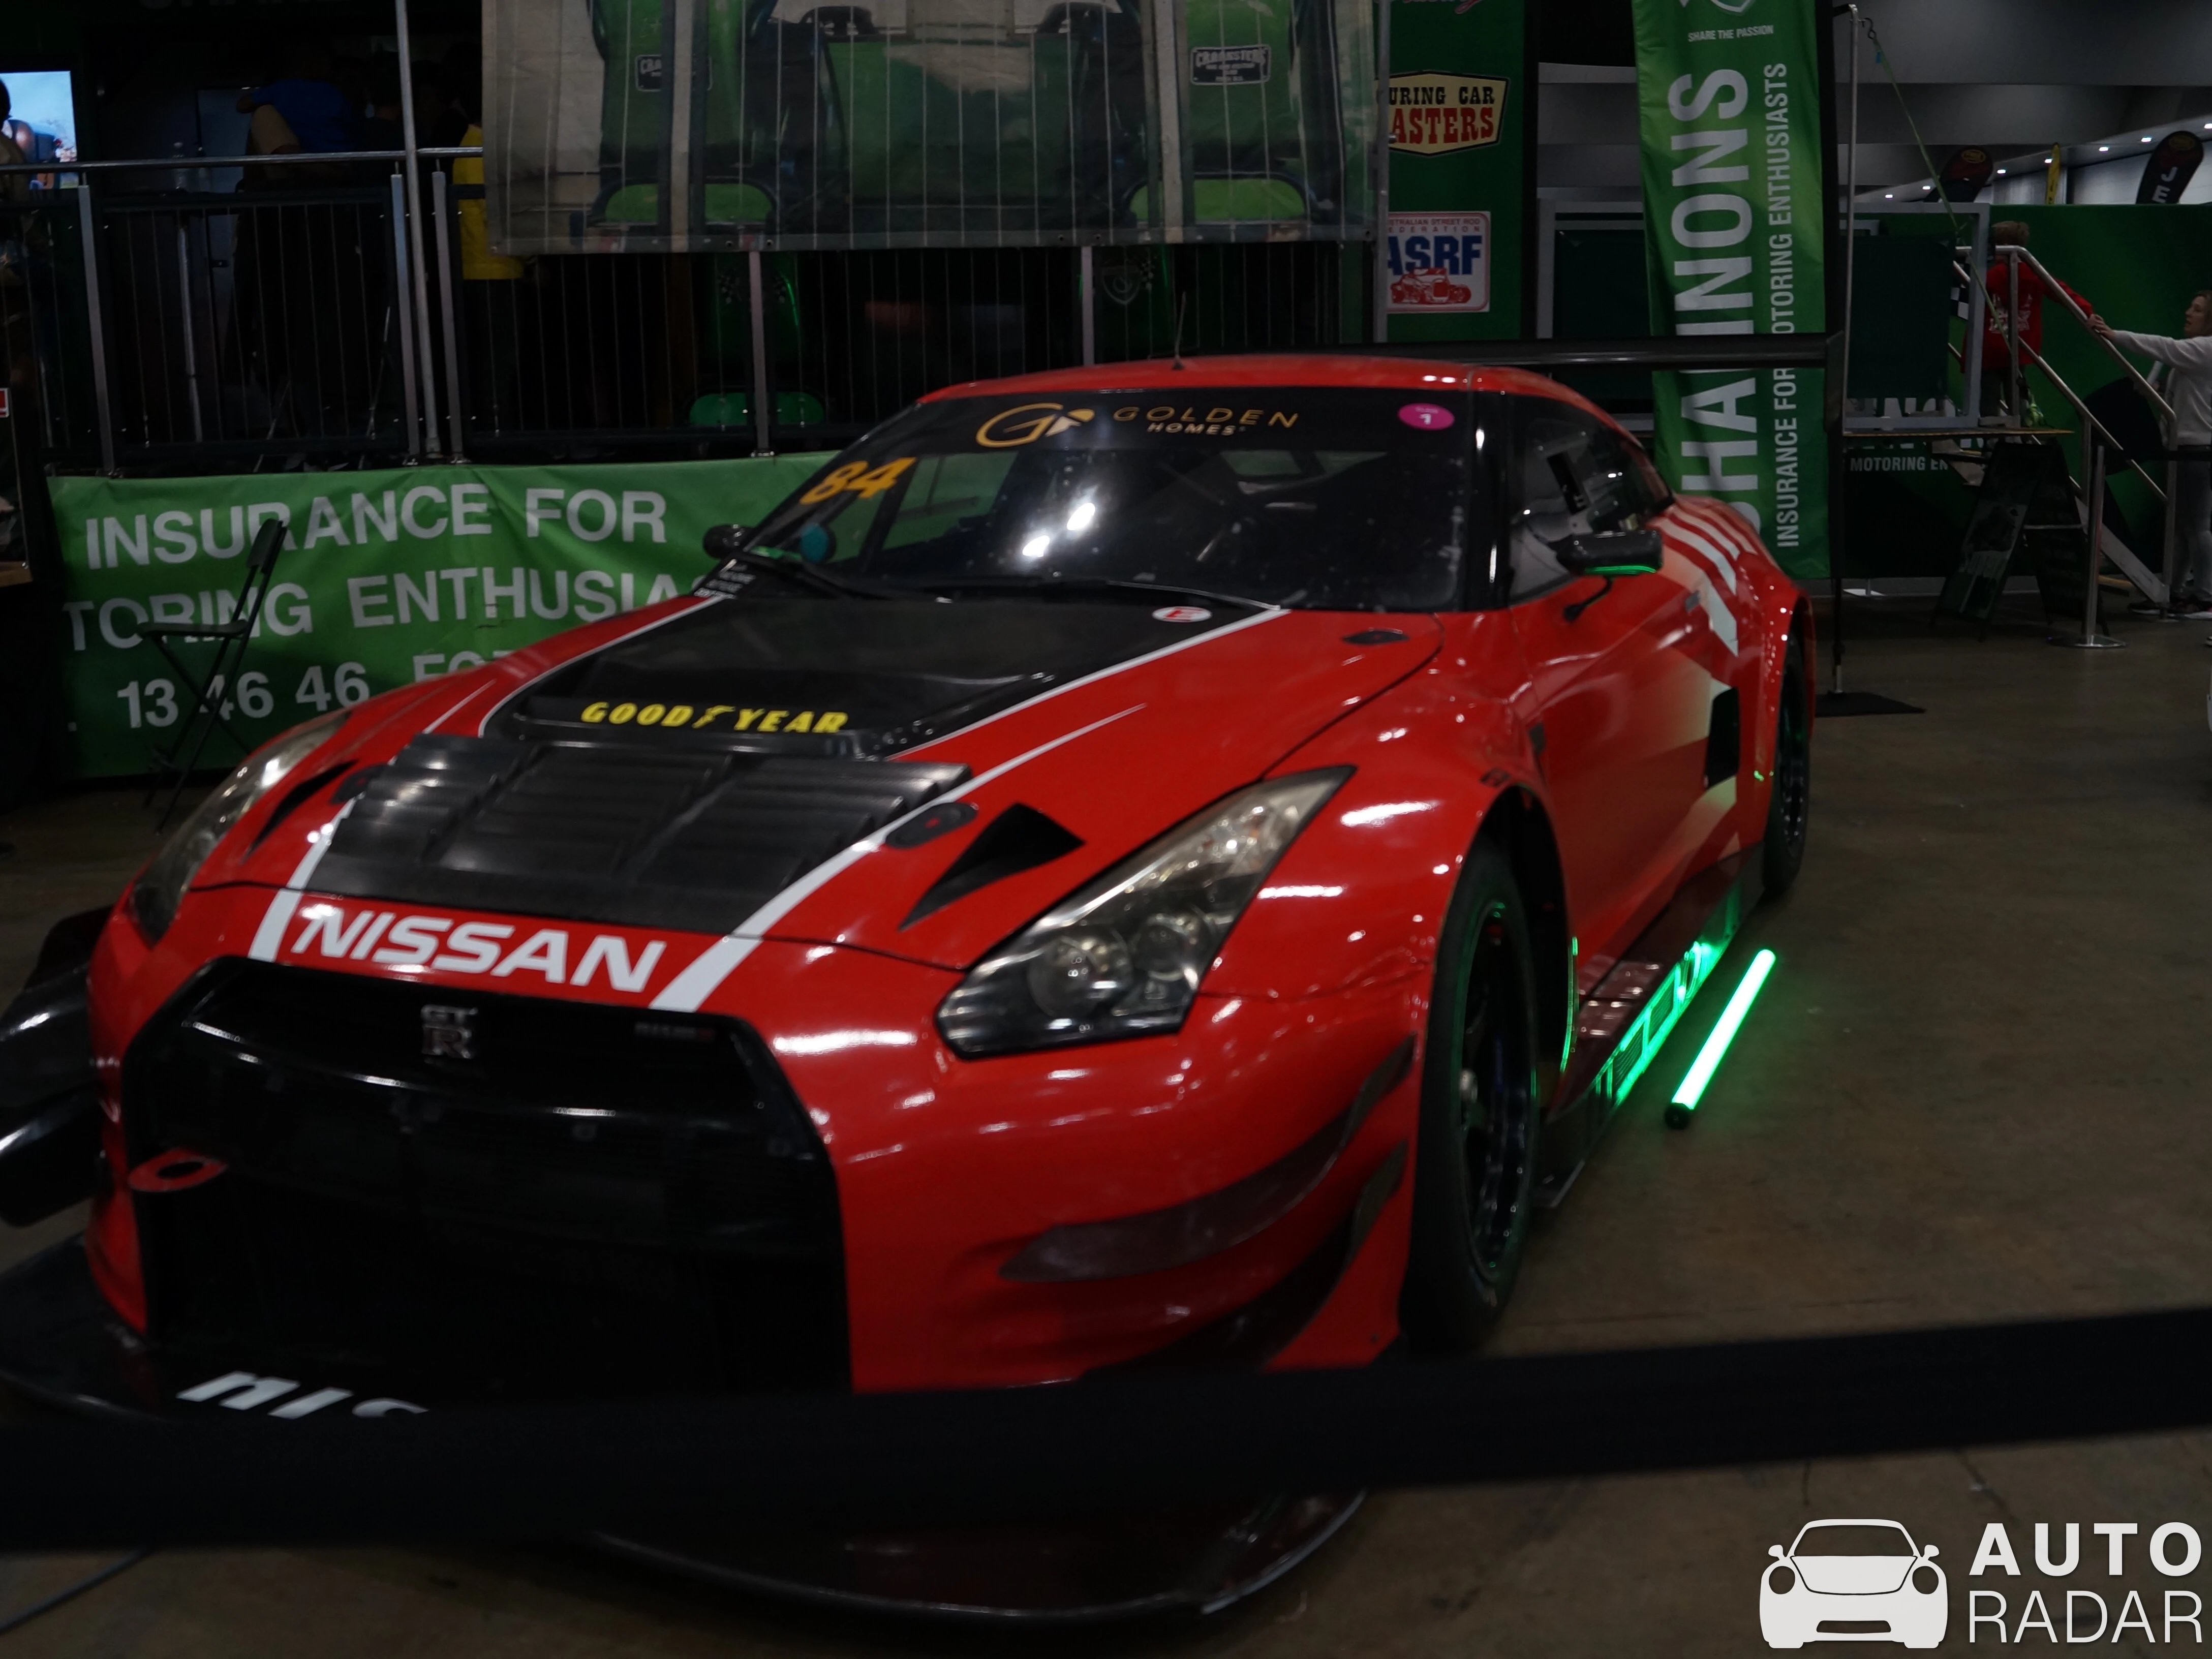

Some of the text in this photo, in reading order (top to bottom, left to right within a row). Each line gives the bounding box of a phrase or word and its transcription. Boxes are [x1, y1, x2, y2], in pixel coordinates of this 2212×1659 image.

[1687, 25, 1774, 42] SHARE THE PASSION
[1389, 86, 1495, 105] URING CAR
[1392, 107, 1494, 144] ASTERS
[1388, 235, 1483, 275] ASRF
[1763, 63, 1799, 548] INSURANCE FOR OTORING ENTHUSIASTS
[1113, 406, 1300, 428] GOLDEN
[1146, 422, 1237, 436] HOMES
[798, 455, 917, 505] 84
[1850, 456, 1949, 472] MOTORING EN
[85, 483, 667, 570] INSURANCE FOR
[347, 565, 706, 628] ENTHUSIA
[116, 678, 179, 729] 13
[294, 661, 371, 712] 46
[291, 908, 667, 993] NISSAN
